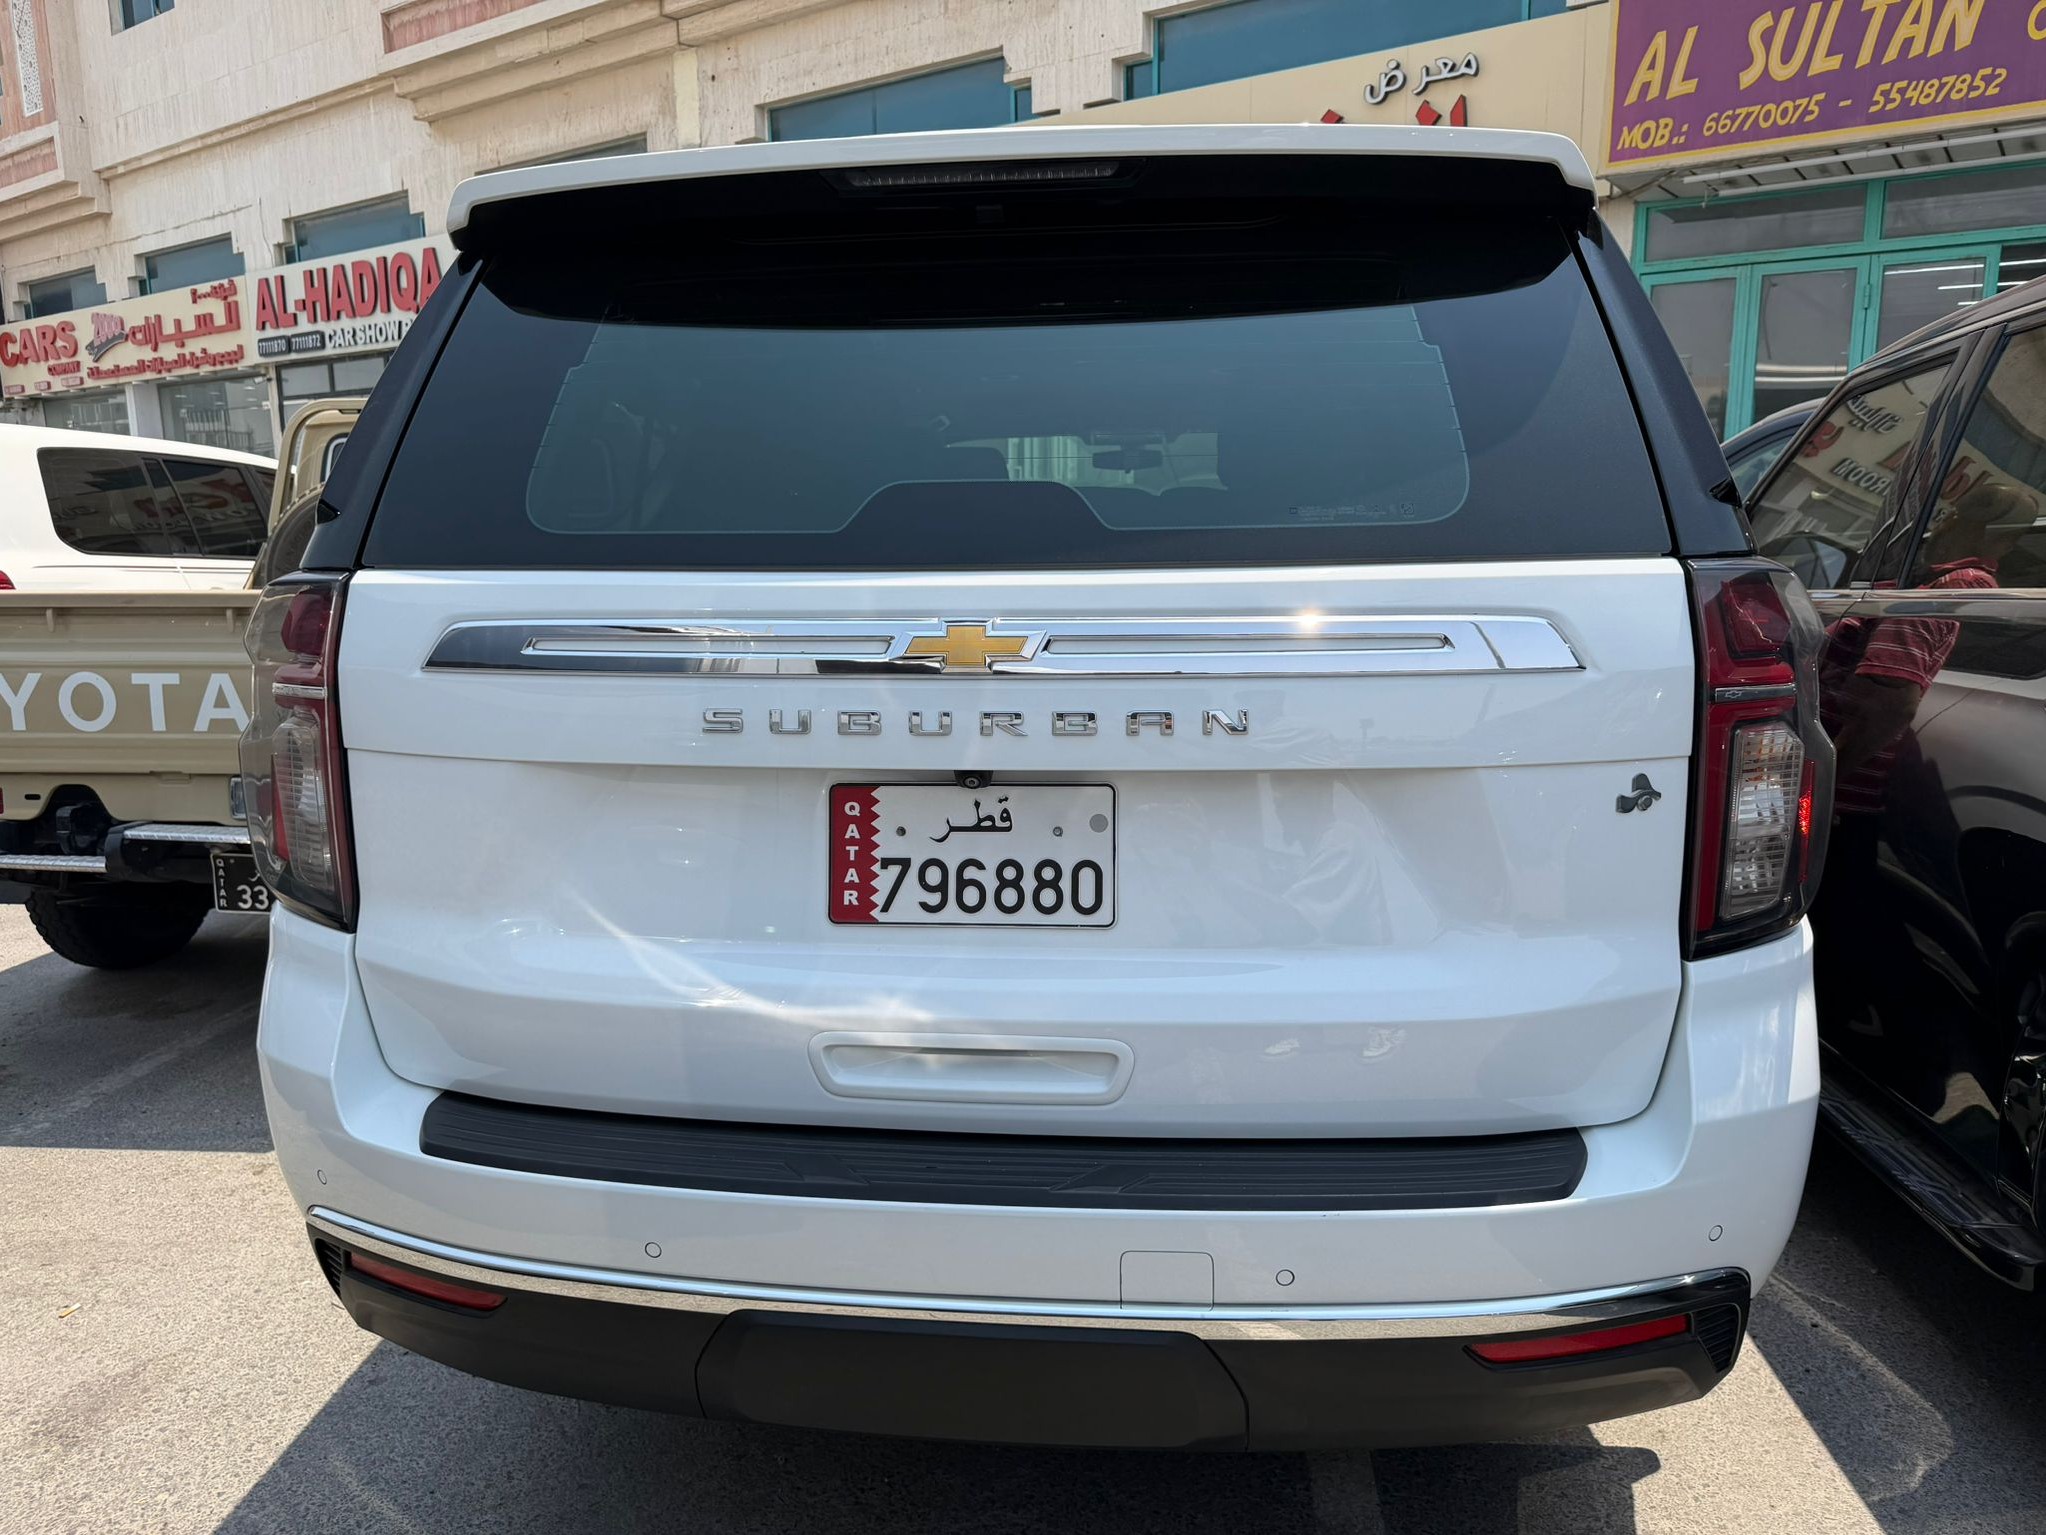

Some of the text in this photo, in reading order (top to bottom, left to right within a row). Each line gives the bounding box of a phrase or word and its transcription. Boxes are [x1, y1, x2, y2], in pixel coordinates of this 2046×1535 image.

[1364, 51, 1480, 105] معرض
[1623, 24, 1699, 107] AL
[1738, 0, 1985, 91] SULTAN
[1702, 92, 1828, 137] 66770075
[1868, 66, 2008, 114] 55487852
[256, 246, 442, 331] AL-HADIQA
[0, 320, 78, 368] CARS
[325, 328, 356, 350] CAR
[358, 320, 400, 346] SHOW
[702, 707, 1250, 737] SUBURBAN
[929, 795, 1014, 843] قطر
[843, 801, 861, 906] QATAR
[216, 858, 228, 908] QATAR
[879, 857, 1104, 916] 796880
